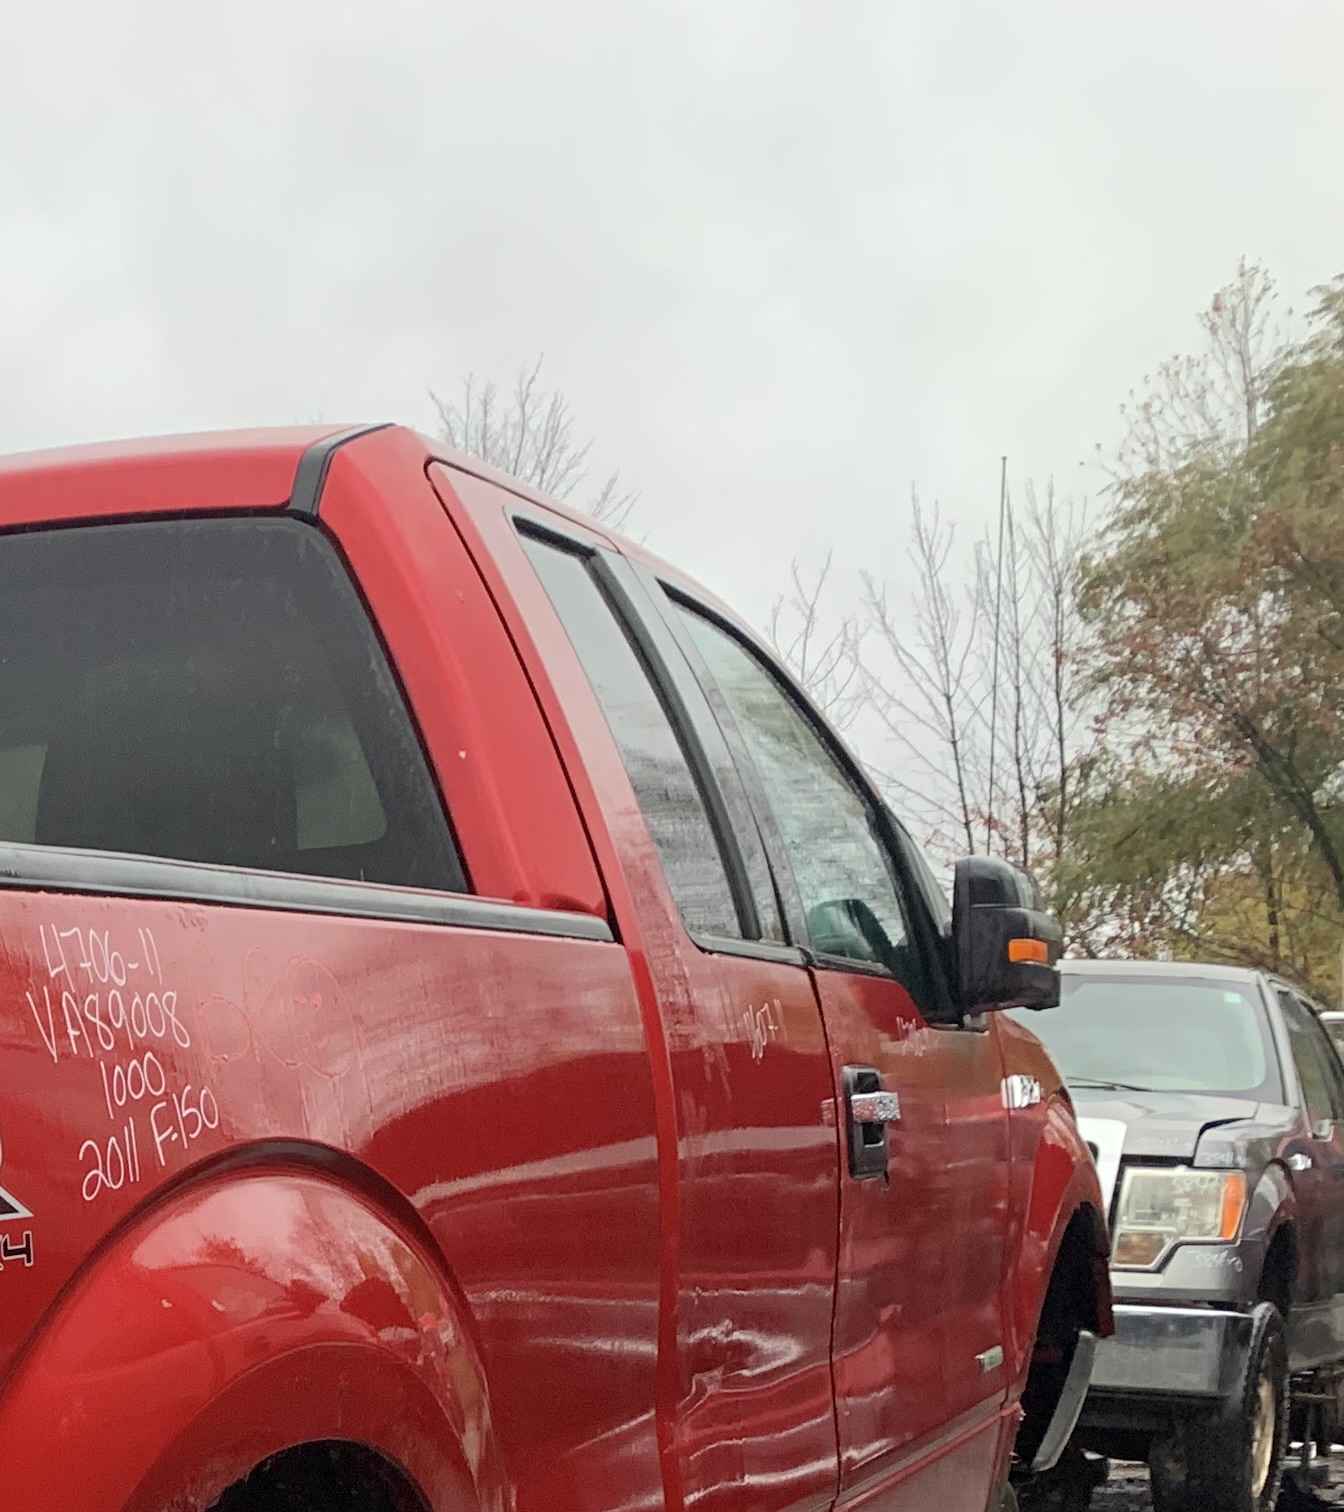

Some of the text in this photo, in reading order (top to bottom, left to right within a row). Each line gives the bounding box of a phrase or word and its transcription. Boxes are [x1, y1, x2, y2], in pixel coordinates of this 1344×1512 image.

[39, 923, 162, 993] 4706-11
[25, 985, 191, 1064] VA89008
[100, 1051, 166, 1120] 1000
[78, 1116, 140, 1201] 2011
